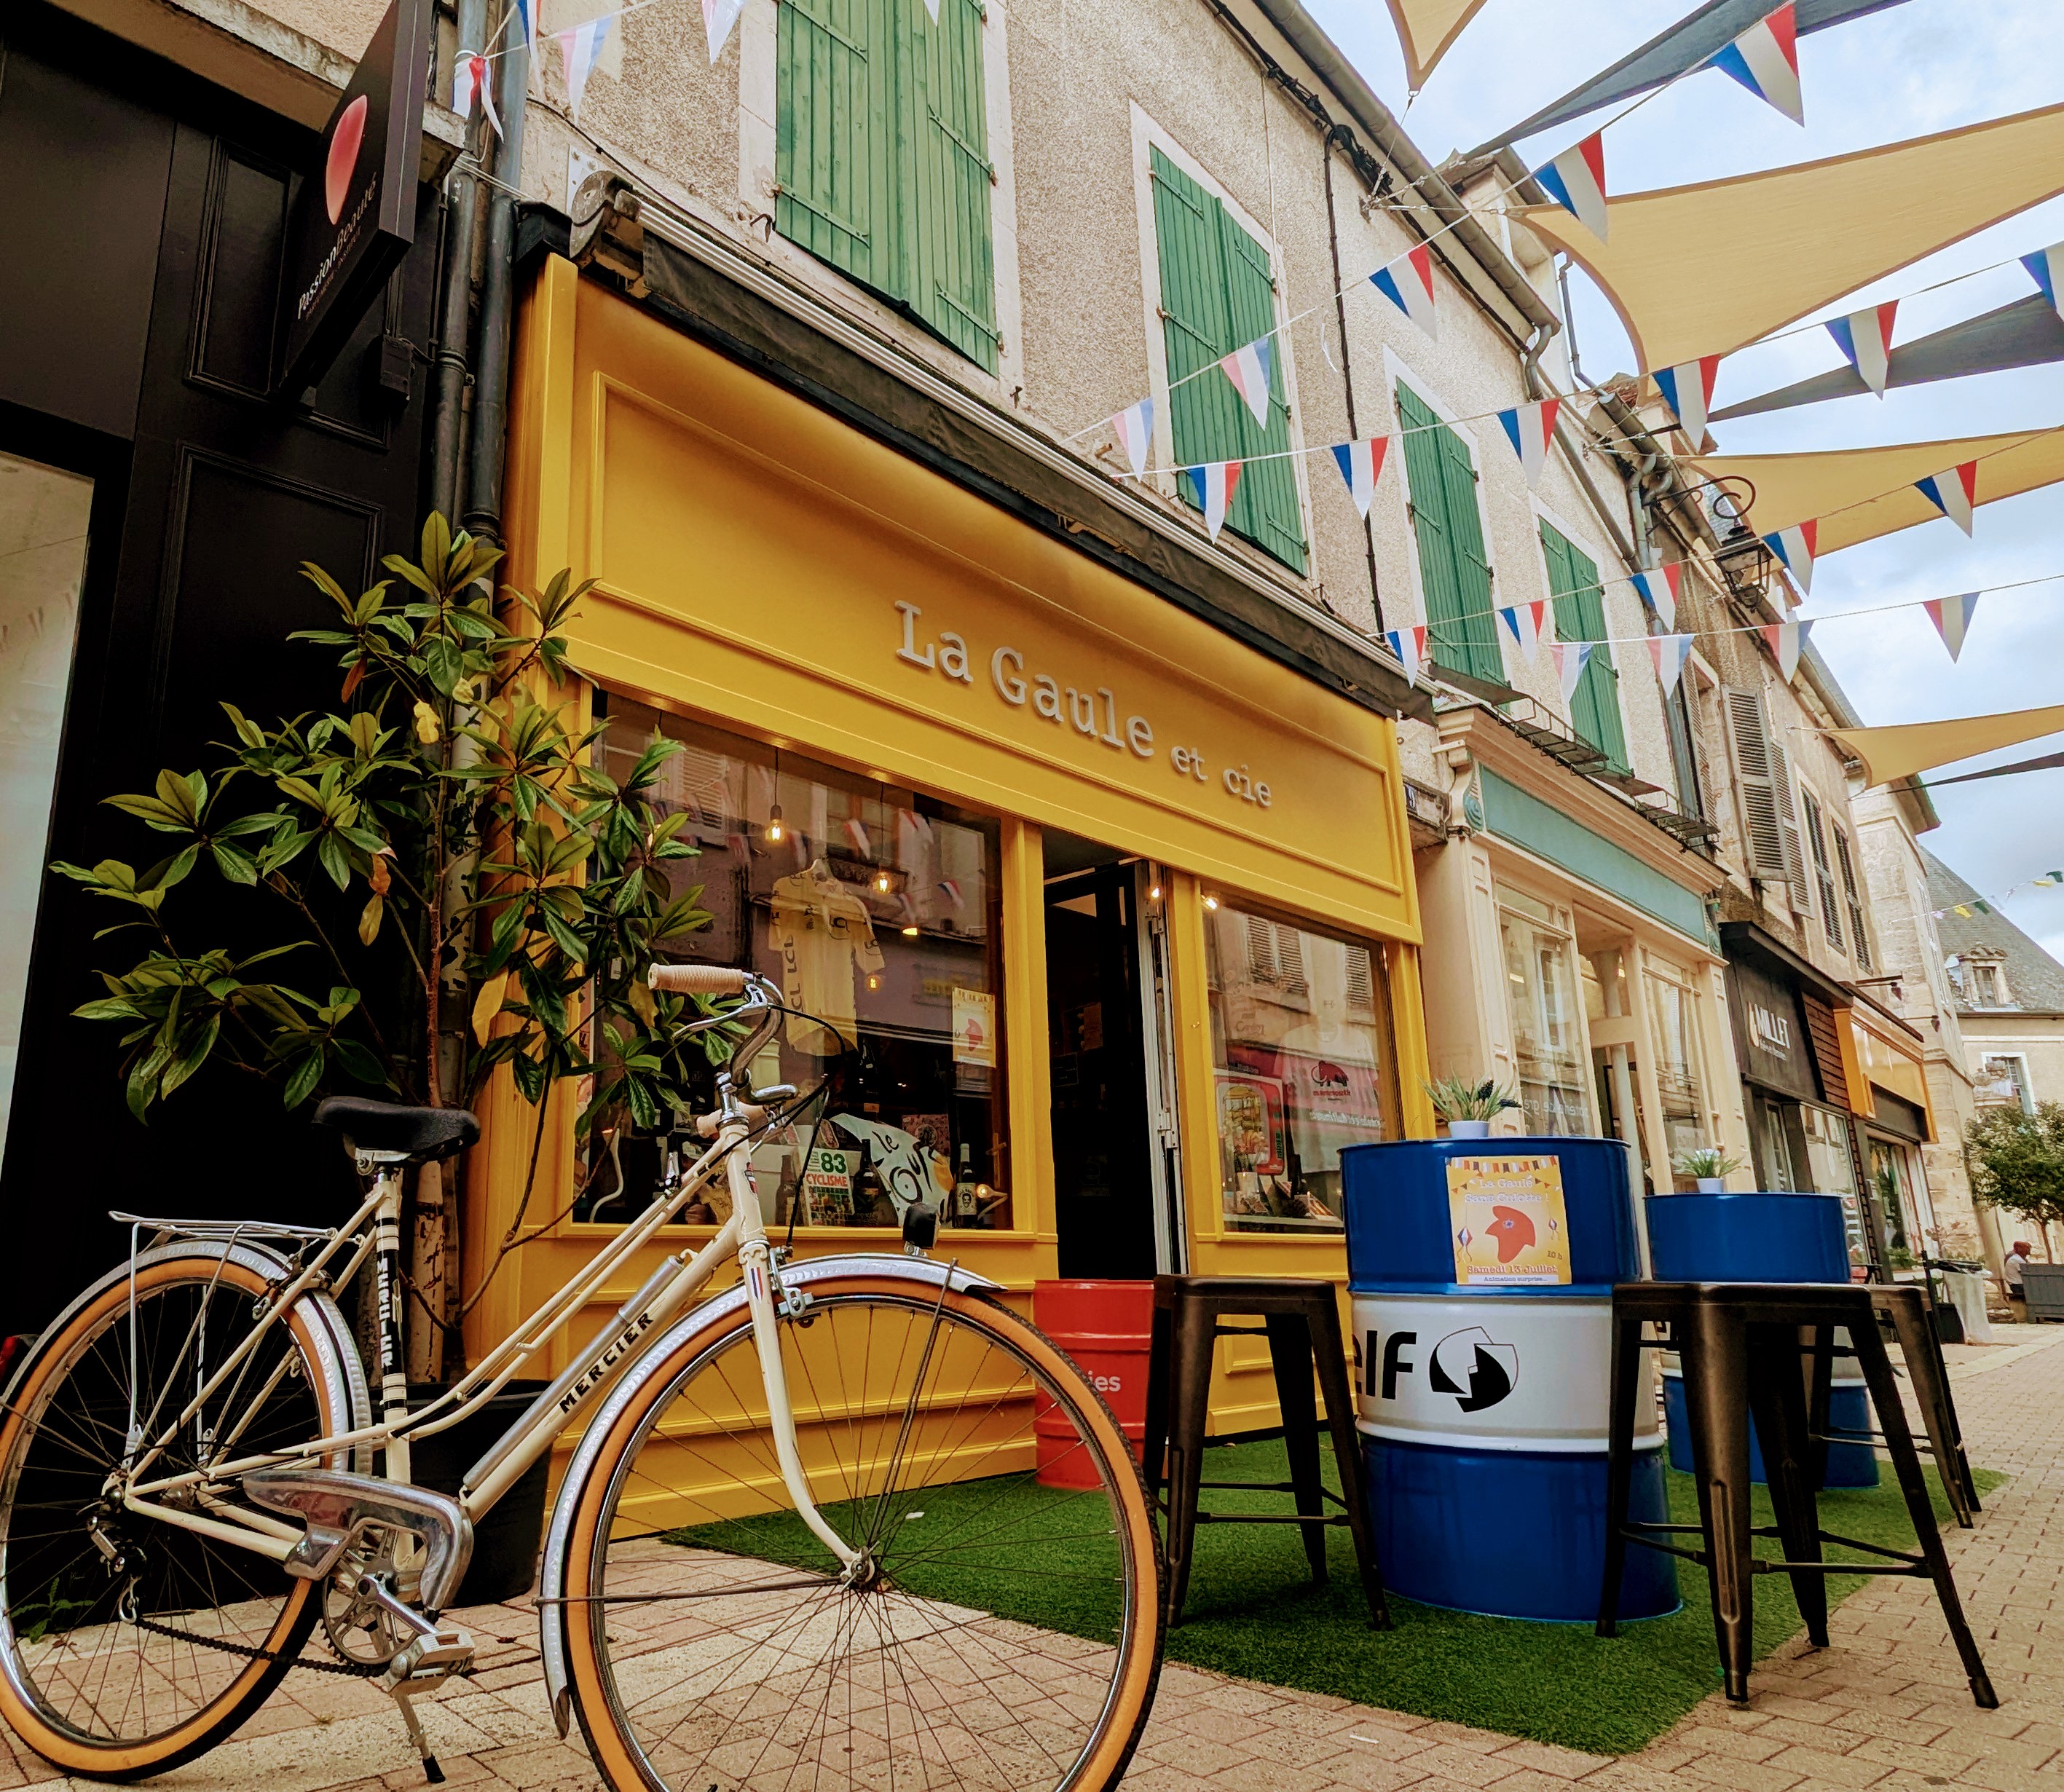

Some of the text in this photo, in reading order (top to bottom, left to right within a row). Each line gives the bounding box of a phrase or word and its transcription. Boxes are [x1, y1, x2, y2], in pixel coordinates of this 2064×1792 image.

[298, 171, 377, 320] PassionBeauté
[894, 599, 1272, 808] La Gaule et cie
[805, 1173, 848, 1187] CYCLISME
[820, 1152, 847, 1174] 83
[1467, 1263, 1506, 1274] Samedi
[1524, 1263, 1559, 1274] Juillet
[1547, 1250, 1556, 1258] 10
[377, 1258, 393, 1369] MERCIER
[559, 1313, 654, 1413] MERCIER
